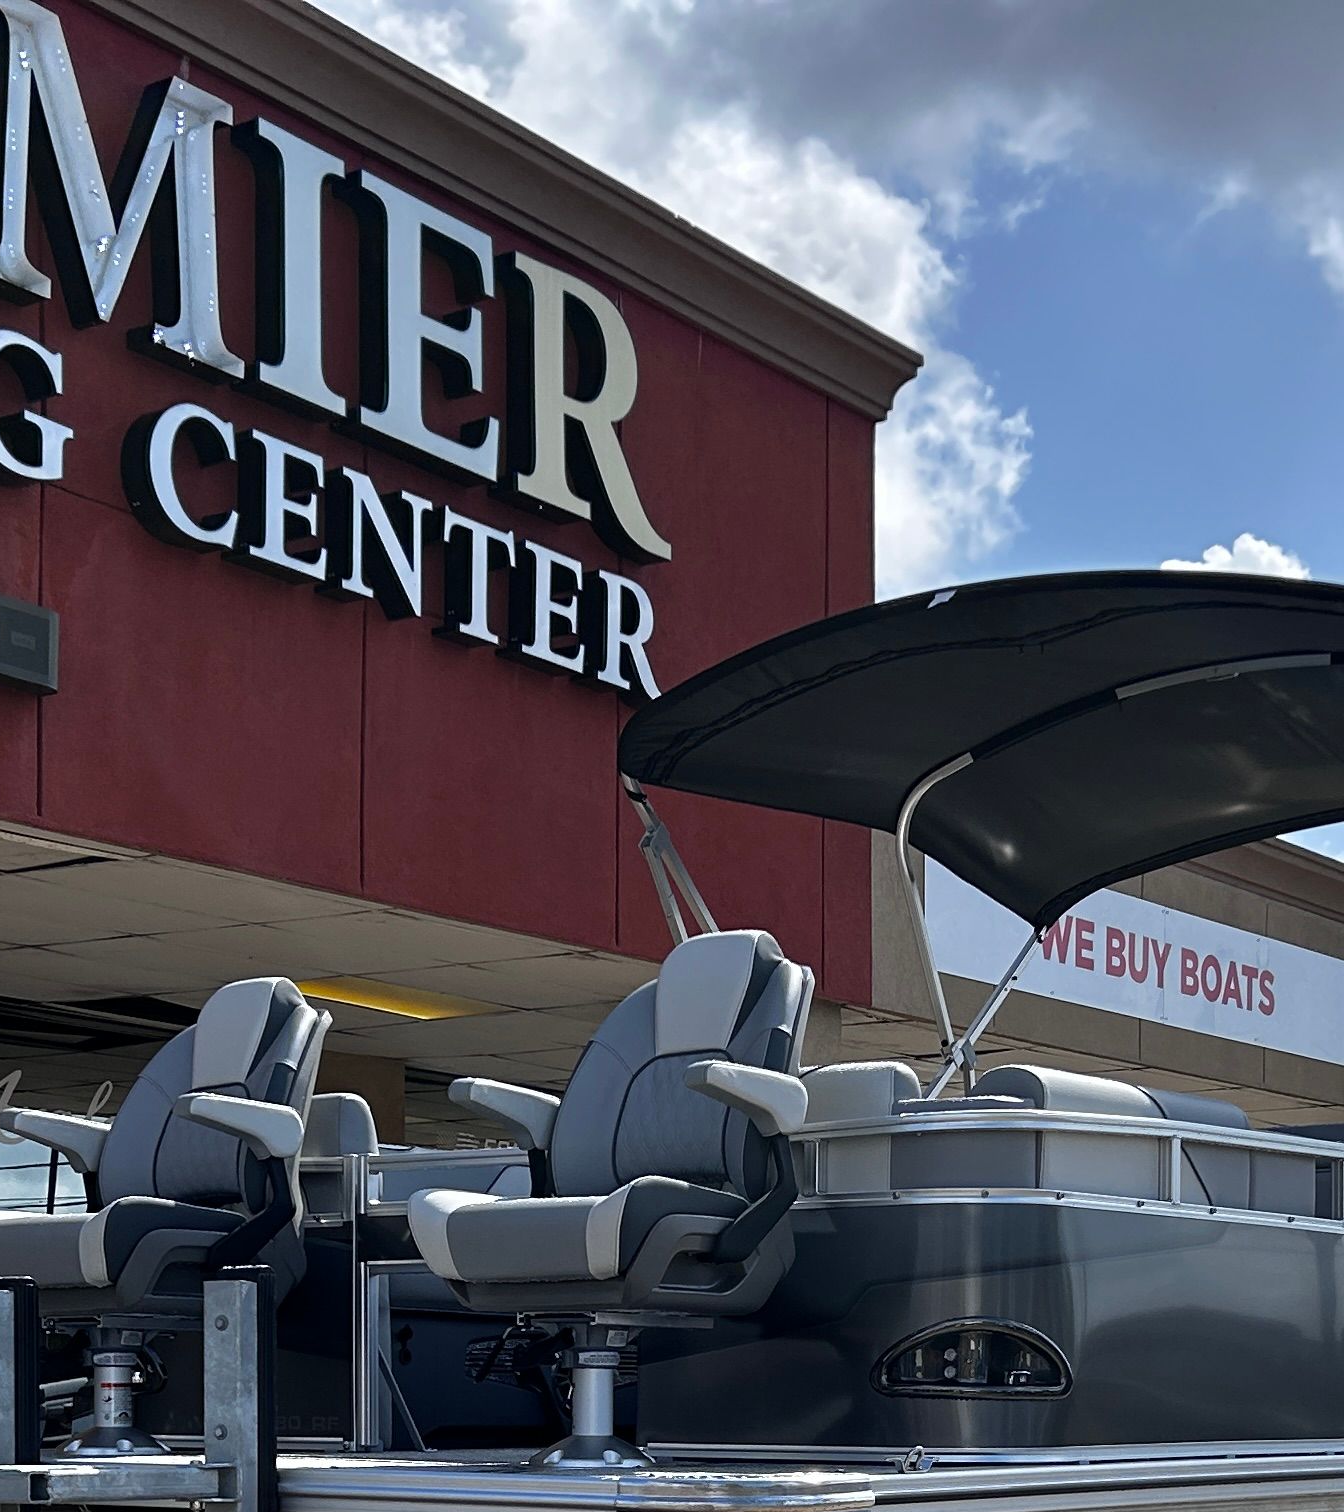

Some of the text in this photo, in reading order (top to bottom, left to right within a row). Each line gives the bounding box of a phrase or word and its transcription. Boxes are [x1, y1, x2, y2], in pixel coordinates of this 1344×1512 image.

[148, 404, 661, 699] CENTER
[1041, 915, 1276, 1016] WE BUY BOATS
